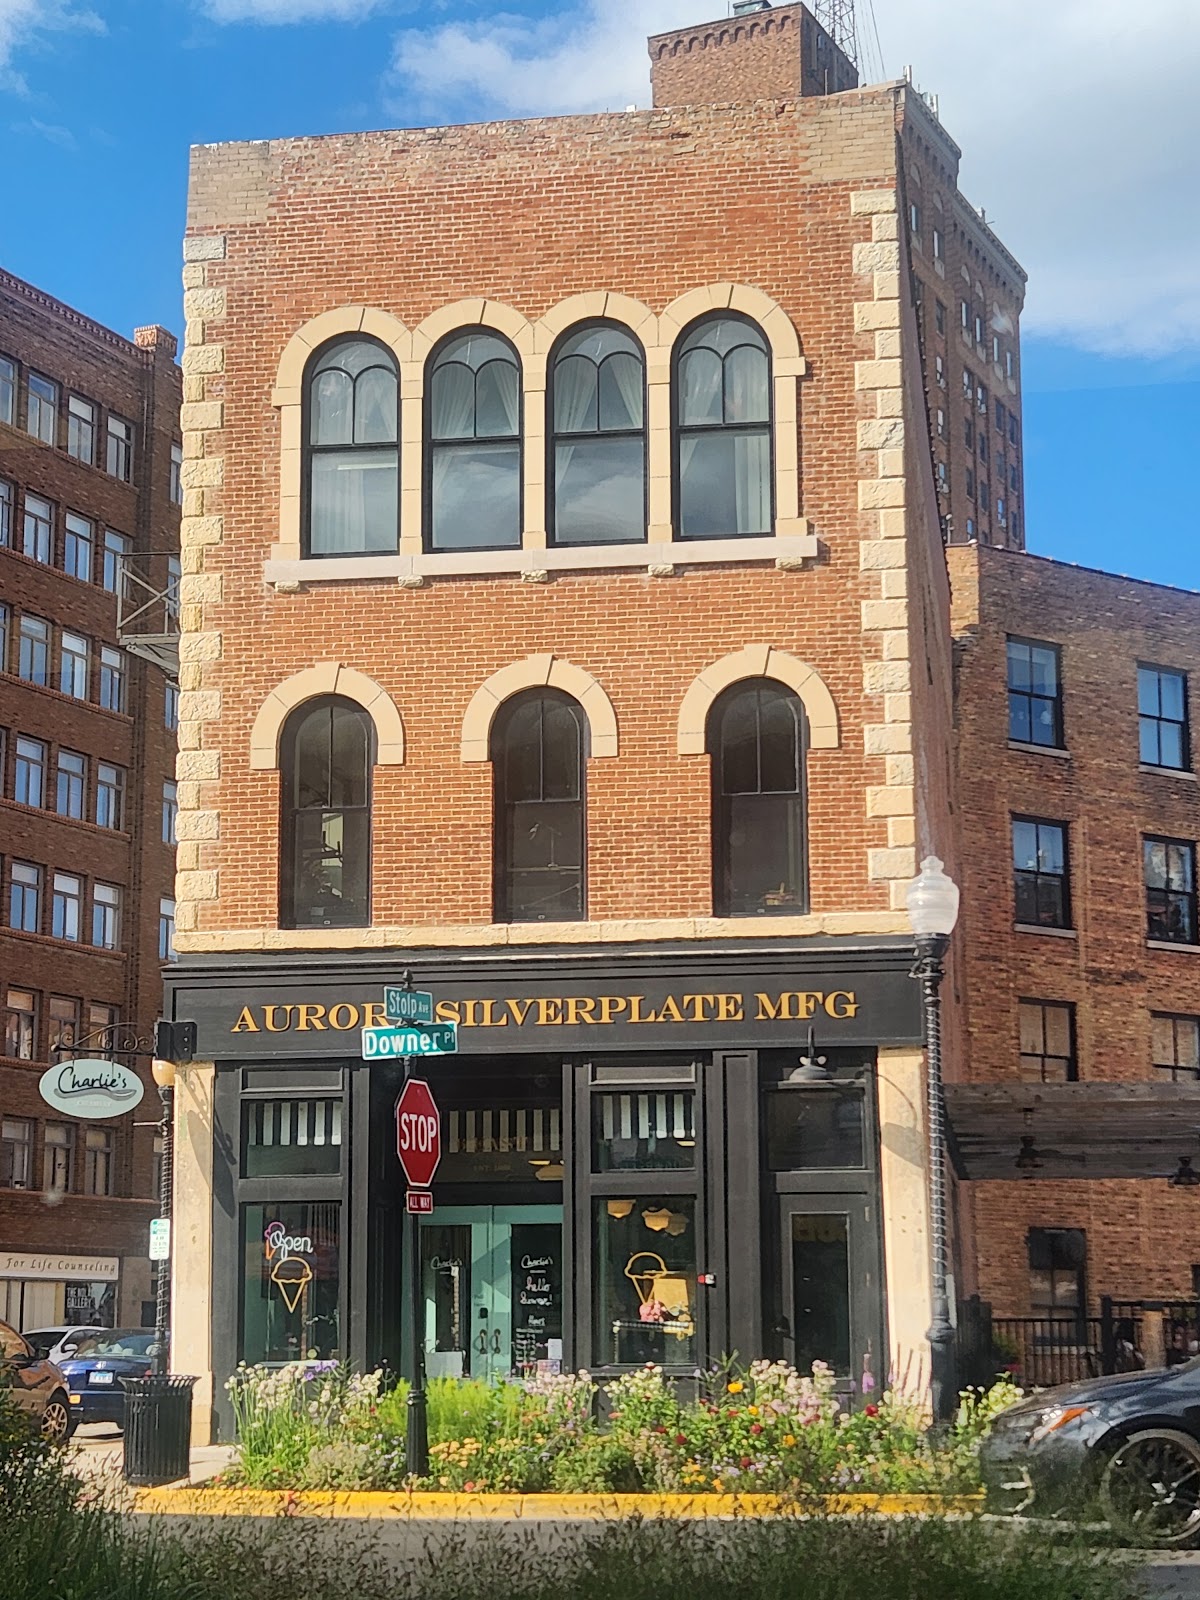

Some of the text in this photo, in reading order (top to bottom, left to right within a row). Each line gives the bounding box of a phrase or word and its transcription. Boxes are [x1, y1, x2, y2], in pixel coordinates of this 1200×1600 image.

[231, 991, 860, 1032] AUROR SILVERPLATE MFG
[389, 990, 429, 1018] Stolp Ave
[366, 1031, 455, 1055] Downer Pl
[58, 1066, 127, 1094] Charlie's
[401, 1112, 437, 1153] STOP
[409, 1196, 431, 1209] ALL WAY
[270, 1230, 314, 1260] Open
[6, 1258, 116, 1275] For Life Counseling
[66, 1287, 77, 1298] THE
